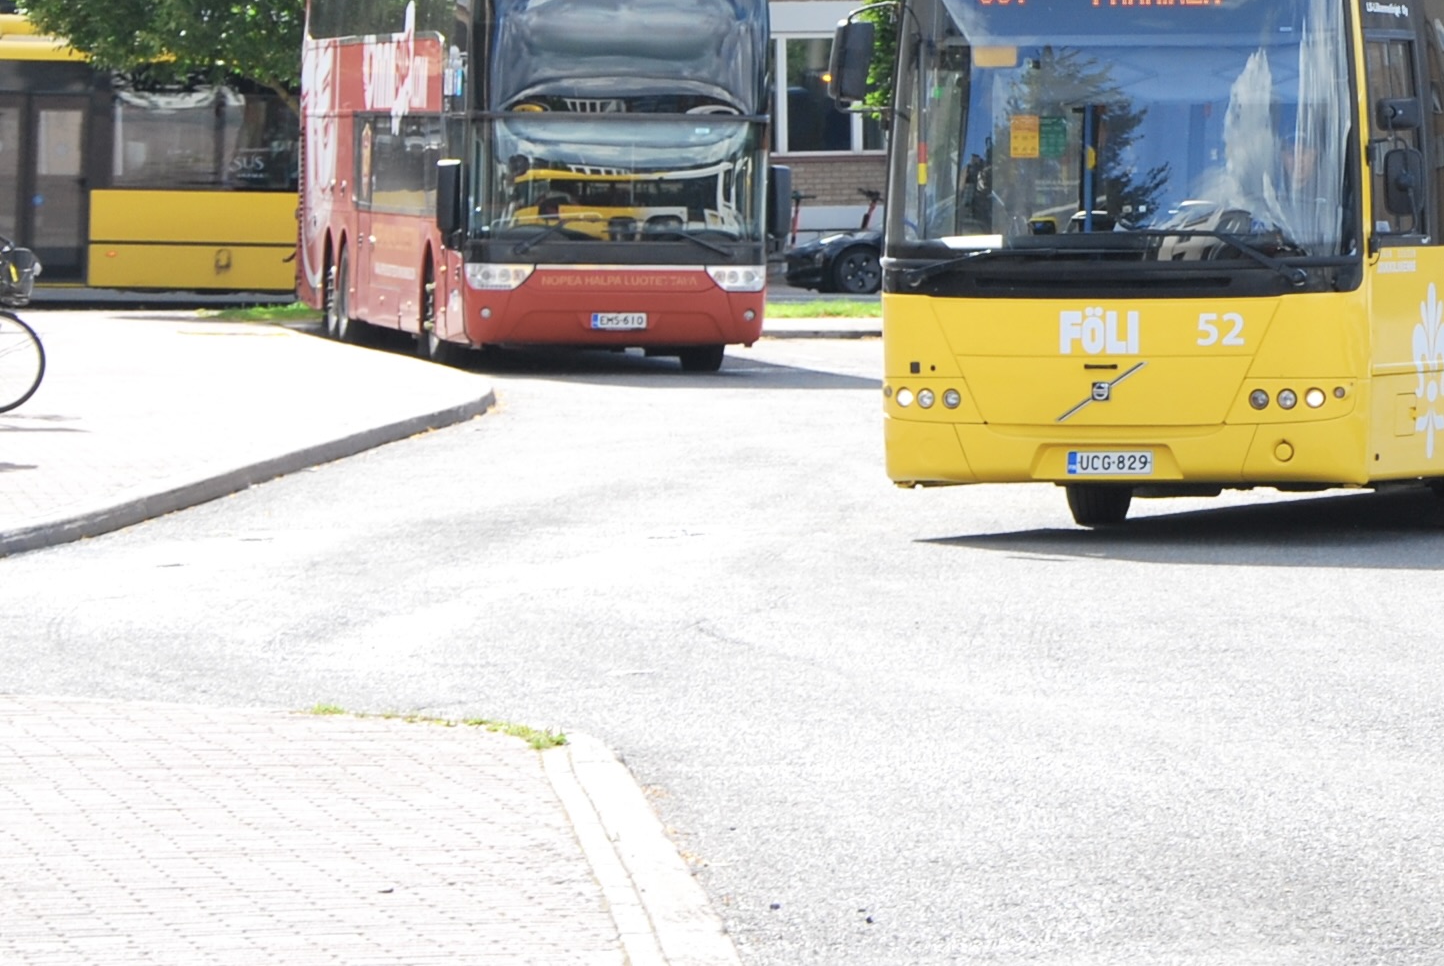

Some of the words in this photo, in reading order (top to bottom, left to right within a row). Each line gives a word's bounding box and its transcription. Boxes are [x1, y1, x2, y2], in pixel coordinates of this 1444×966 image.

[542, 275, 583, 286] NOPEA
[584, 275, 623, 286] HALPA
[1060, 307, 1139, 354] FÖLI
[1197, 312, 1245, 346] 52
[1080, 455, 1149, 471] UCG-829
